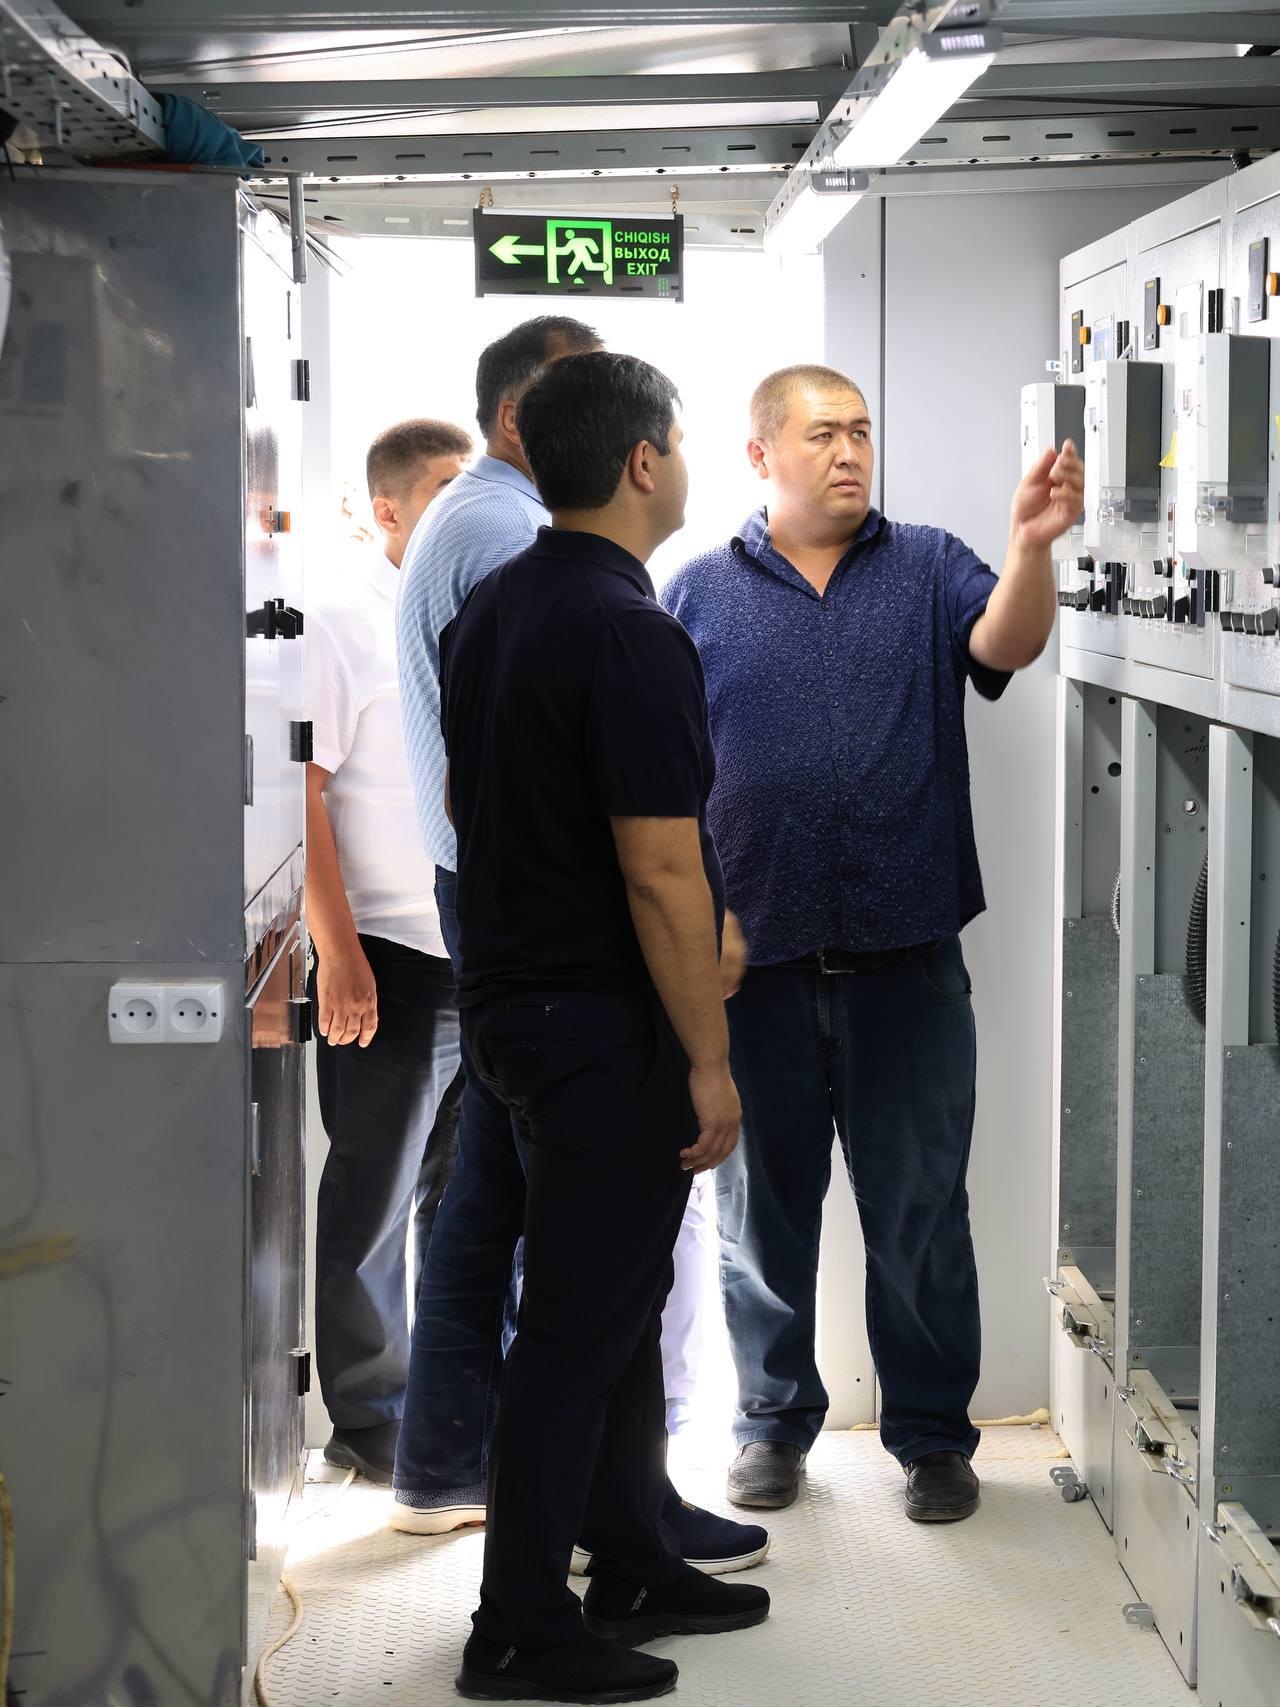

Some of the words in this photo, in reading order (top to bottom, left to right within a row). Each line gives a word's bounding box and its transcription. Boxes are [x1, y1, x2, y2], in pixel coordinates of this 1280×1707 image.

[614, 231, 670, 244] CHIQISH
[614, 247, 671, 262] ВЫХОД
[627, 262, 659, 276] EXIT
